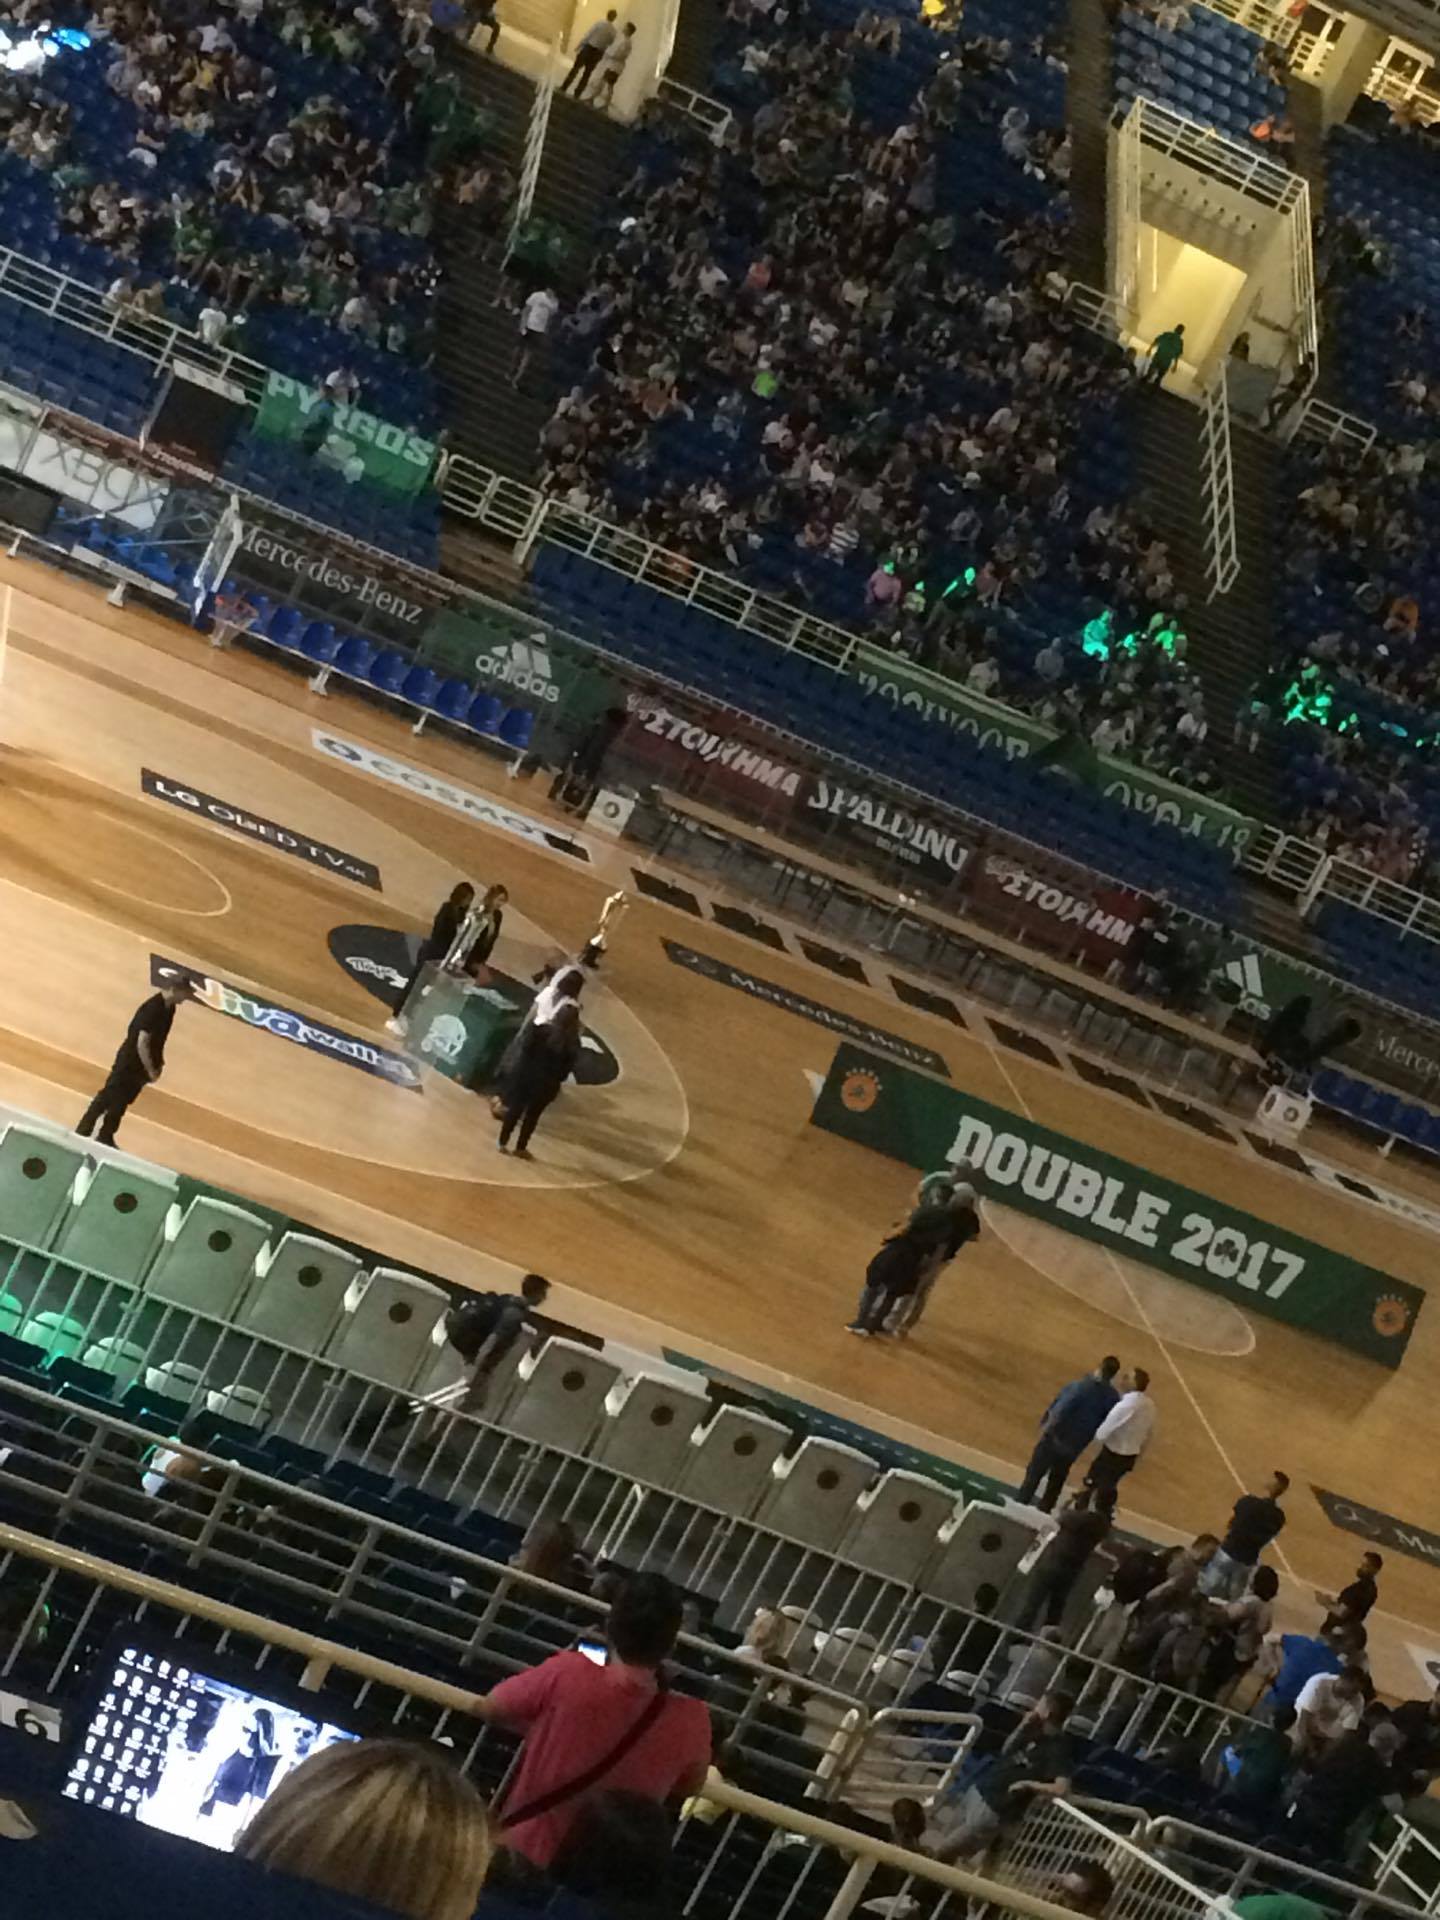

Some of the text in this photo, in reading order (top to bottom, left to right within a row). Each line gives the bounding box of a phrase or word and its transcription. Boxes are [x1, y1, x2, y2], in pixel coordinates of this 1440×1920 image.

[475, 655, 560, 703] adidas
[155, 780, 201, 808] LG
[945, 1114, 1306, 1300] DOUBLE 2017
